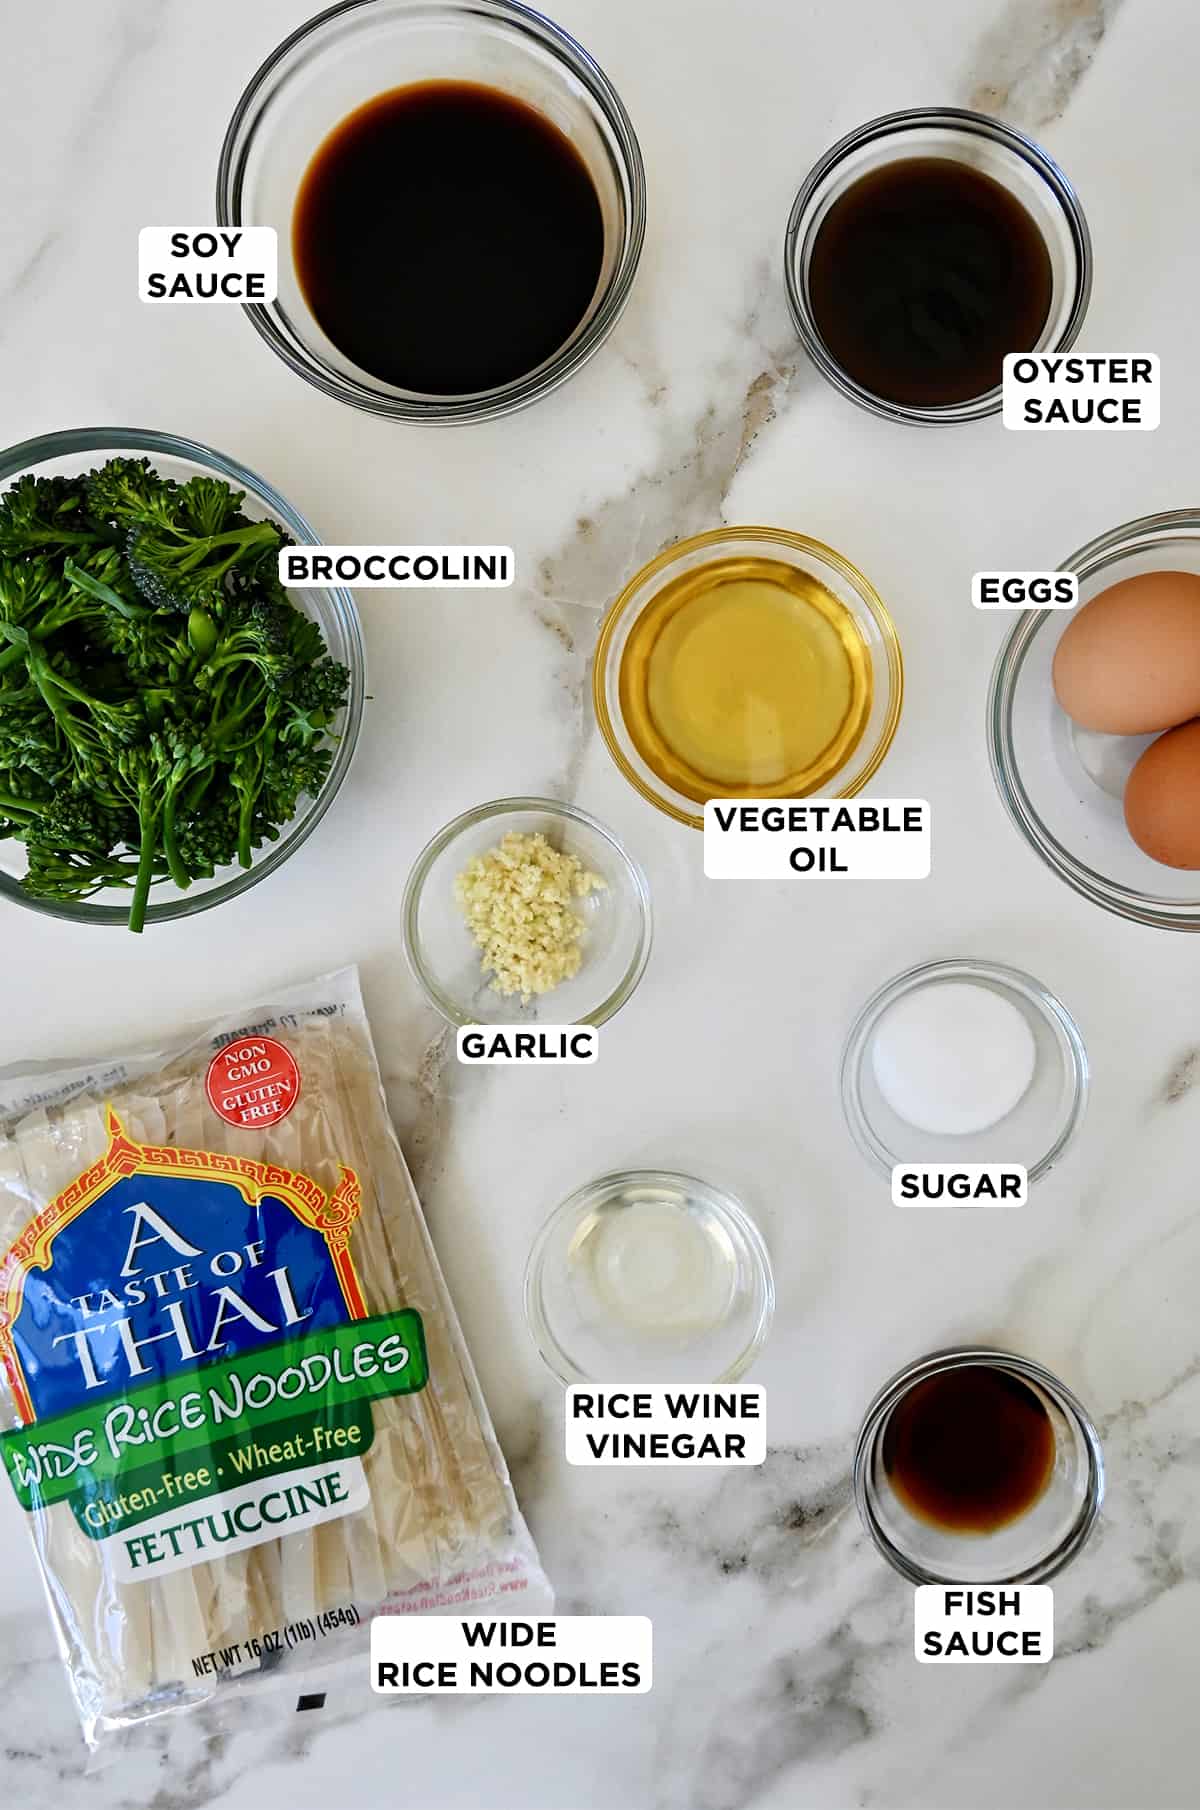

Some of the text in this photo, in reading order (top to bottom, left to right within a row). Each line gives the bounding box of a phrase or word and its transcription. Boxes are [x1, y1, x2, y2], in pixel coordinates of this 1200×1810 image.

[225, 1043, 266, 1065] NON
[228, 1058, 271, 1081] GMO
[222, 1079, 291, 1110] GLUTEN
[240, 1099, 283, 1122] FREE
[120, 1201, 204, 1277] A
[71, 1240, 264, 1319] TASTE OF
[52, 1267, 312, 1389] THAI
[209, 1335, 410, 1424] NOODLES
[83, 1422, 362, 1528] Gluten-Free Wheat-Free
[125, 1471, 350, 1569] FETTUCCINE
[192, 1652, 219, 1678] NET
[220, 1644, 243, 1668] WT
[244, 1639, 260, 1660] 16
[263, 1631, 284, 1652] OZ
[318, 1604, 360, 1637] (454g)
